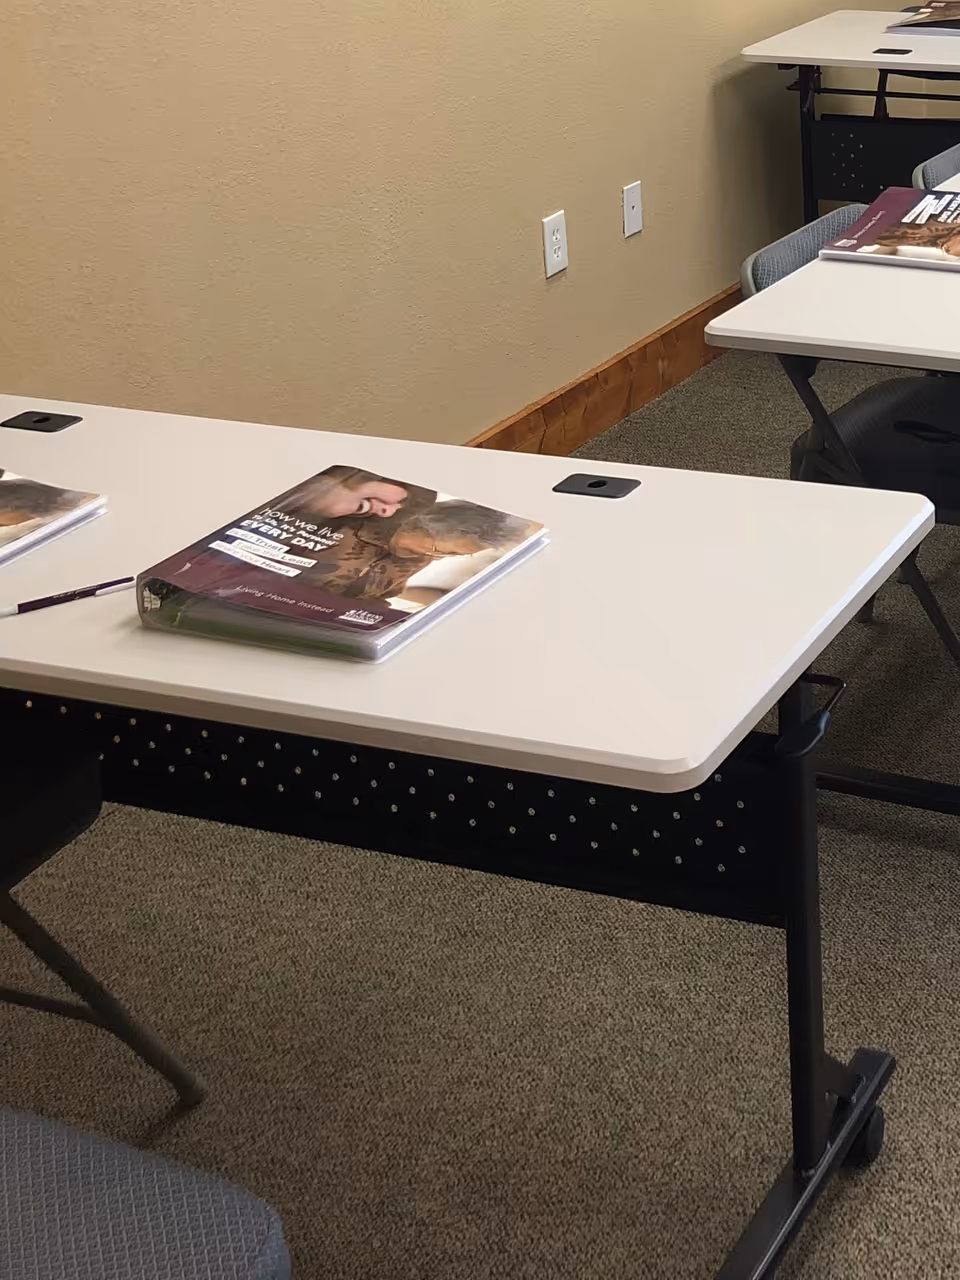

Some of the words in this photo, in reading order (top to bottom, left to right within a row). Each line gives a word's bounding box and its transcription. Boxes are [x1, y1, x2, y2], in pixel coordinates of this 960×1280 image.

[259, 507, 295, 521] how
[295, 519, 318, 532] we
[318, 526, 344, 540] live
[240, 519, 294, 540] EVERY
[291, 537, 328, 552] DAY
[255, 538, 284, 552] Trust
[280, 555, 313, 566] Lead
[235, 585, 264, 597] Living
[265, 592, 296, 605] Home
